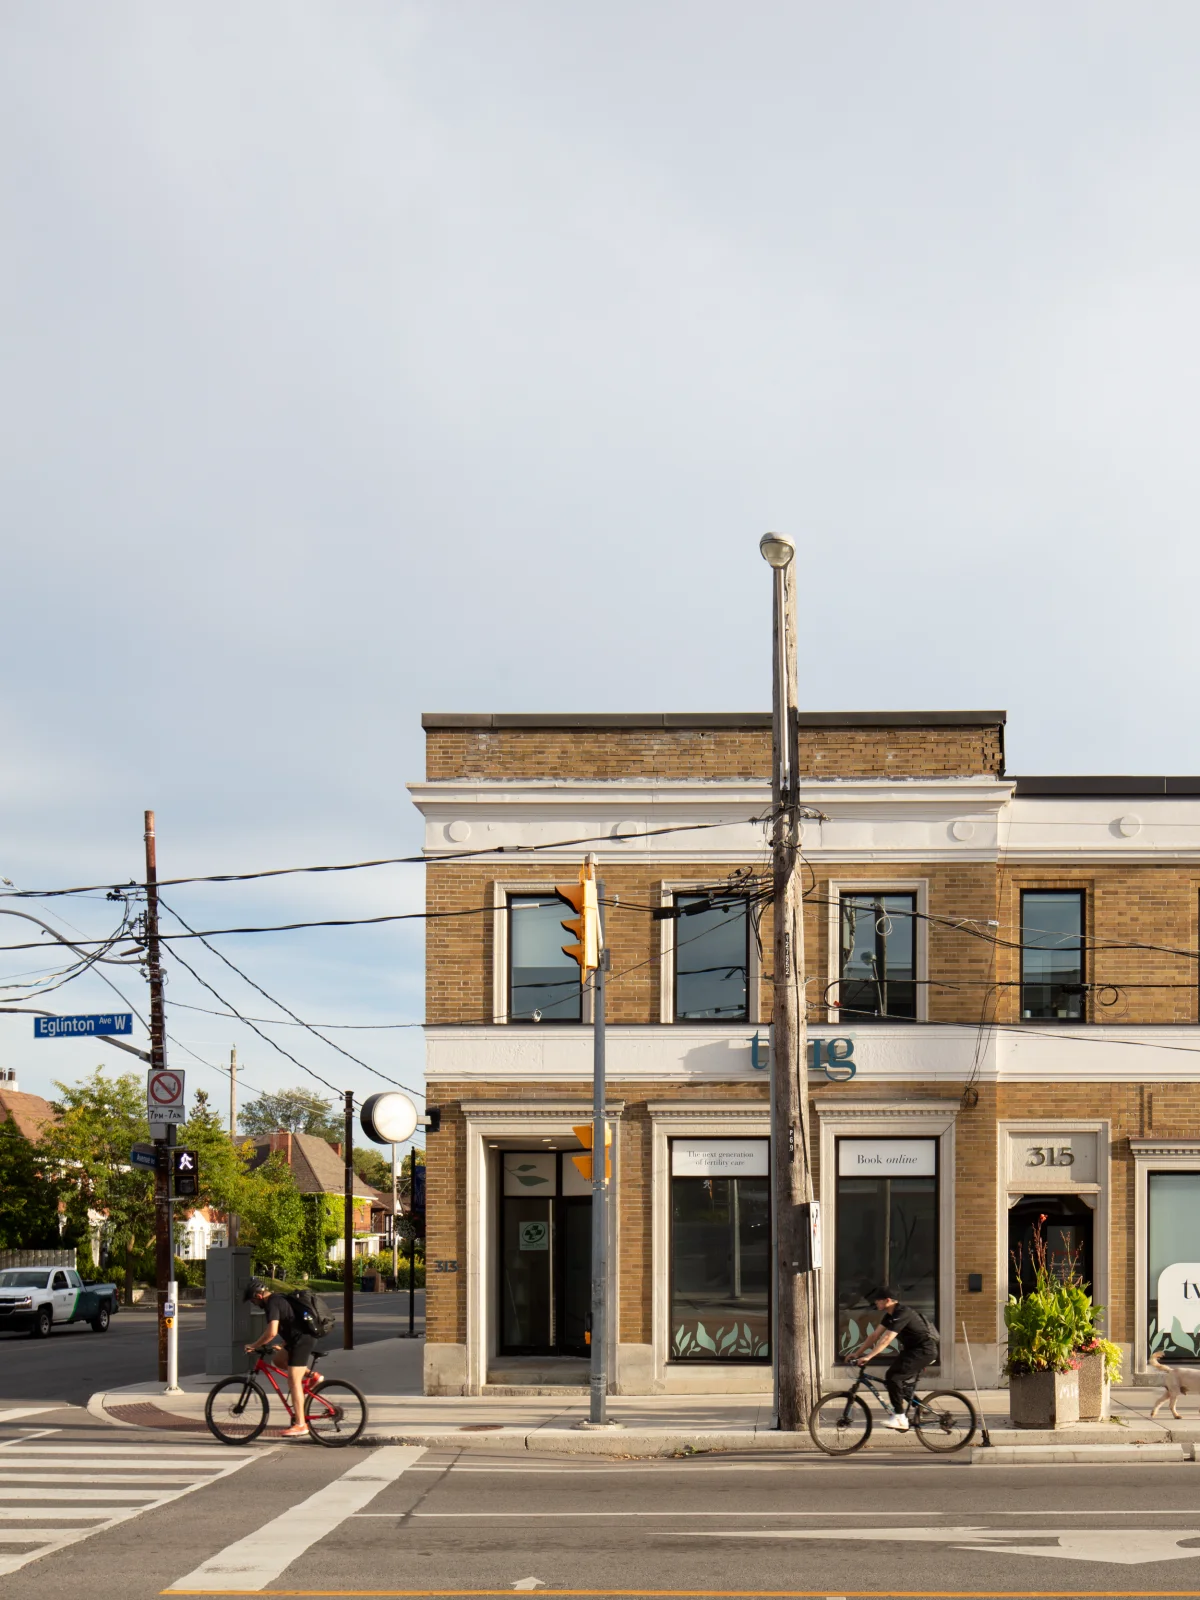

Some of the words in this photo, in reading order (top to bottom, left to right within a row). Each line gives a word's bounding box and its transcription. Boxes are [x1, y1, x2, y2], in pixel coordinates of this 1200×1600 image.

[40, 1018, 95, 1037] Eglinton
[98, 1016, 112, 1025] Ave
[114, 1015, 126, 1030] W
[746, 1030, 856, 1082] tig
[718, 1151, 754, 1159] generation
[857, 1154, 883, 1164] Book
[886, 1154, 918, 1164] online
[1027, 1147, 1075, 1167] 315
[704, 1159, 729, 1168] fertility
[434, 1260, 459, 1273] 313
